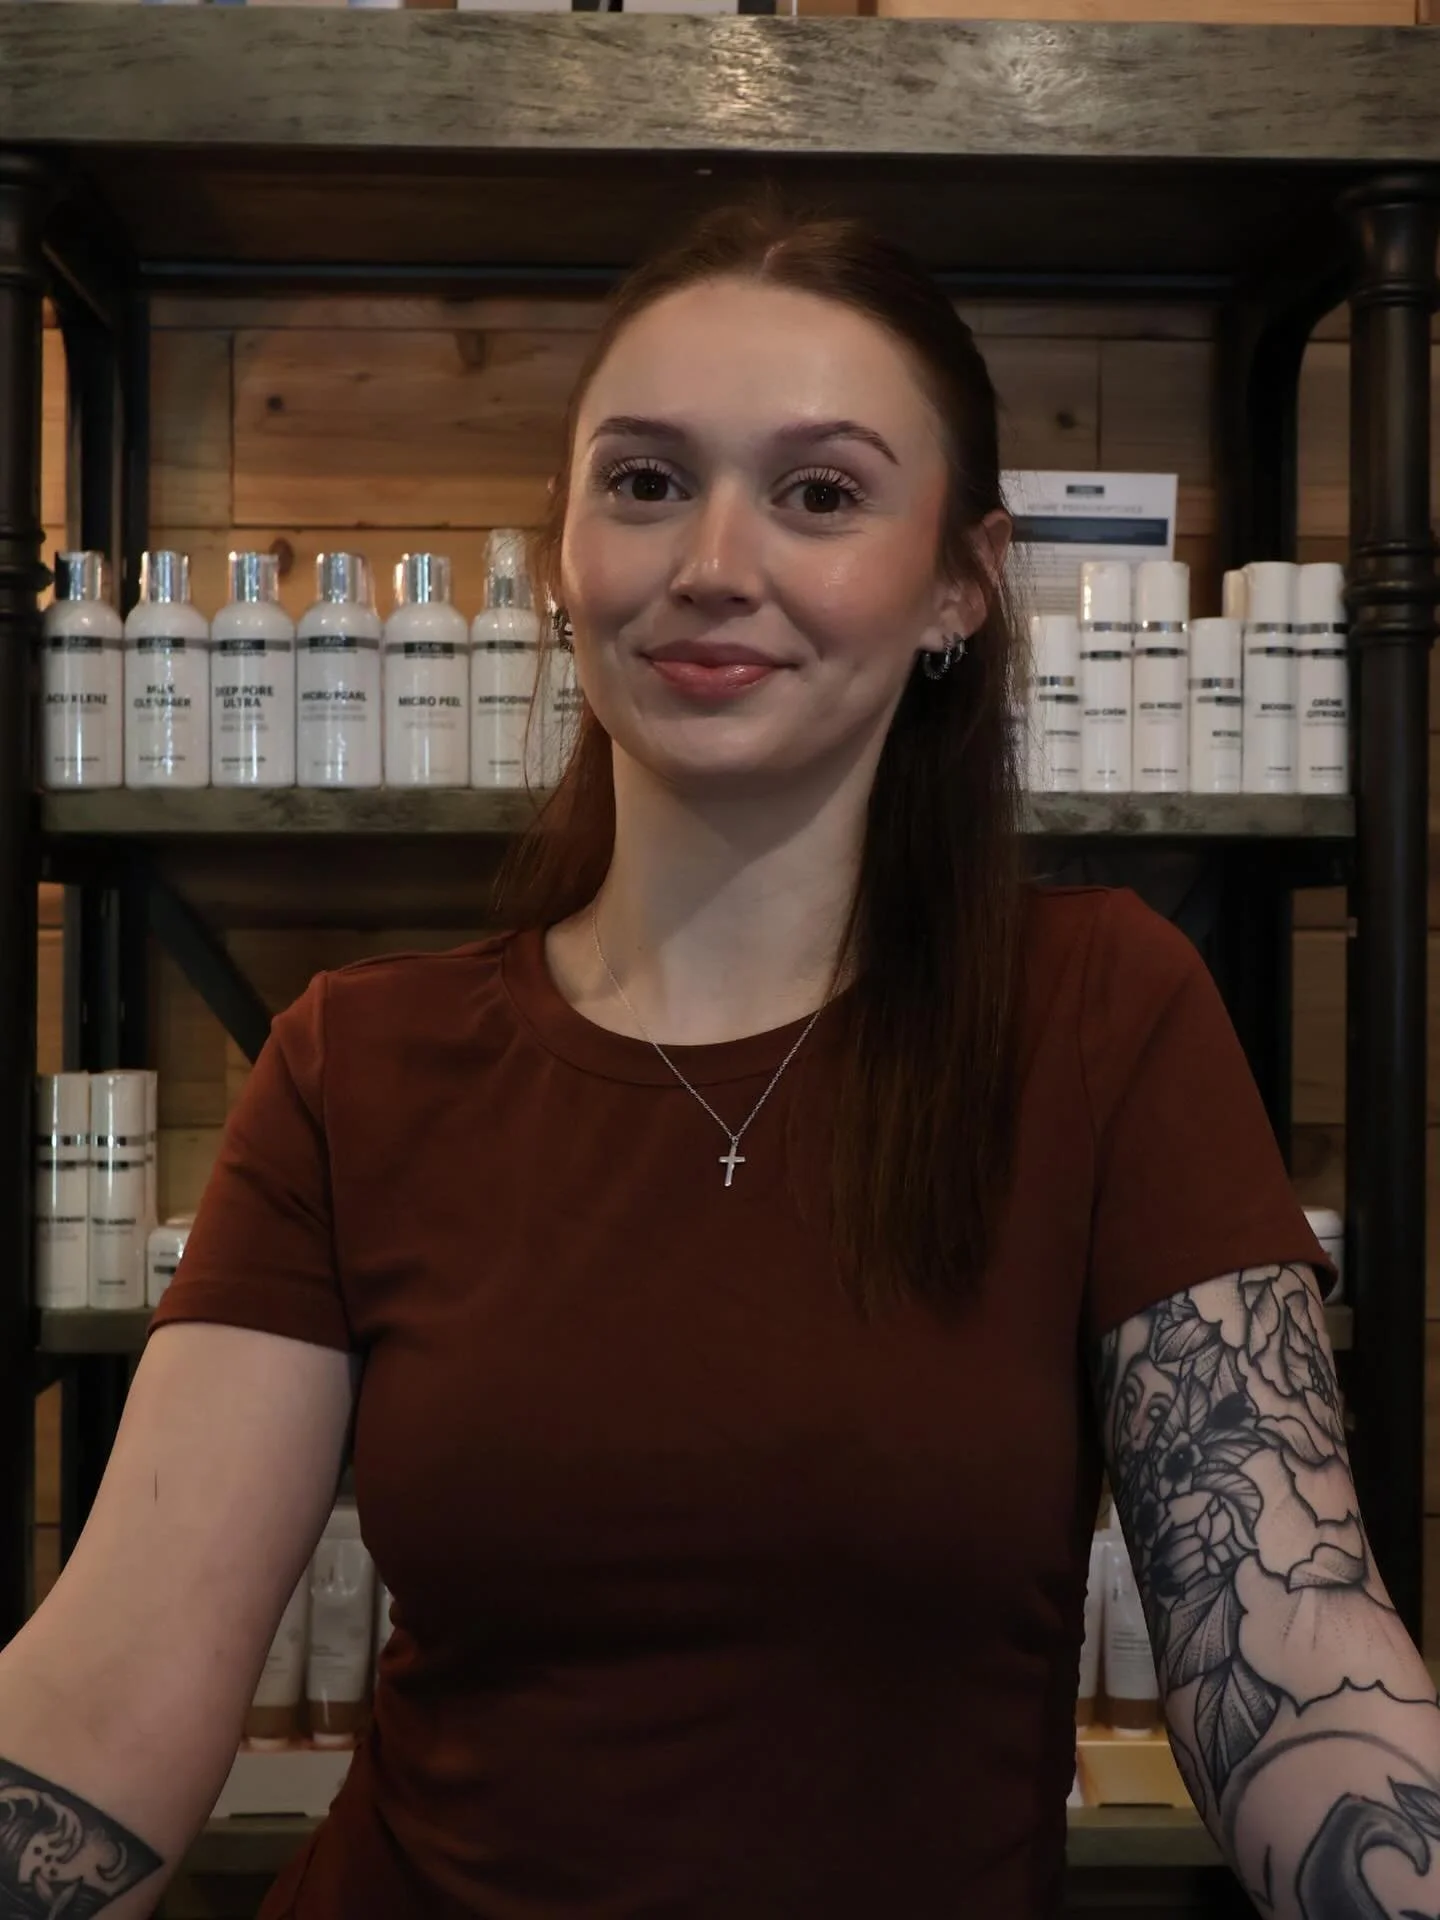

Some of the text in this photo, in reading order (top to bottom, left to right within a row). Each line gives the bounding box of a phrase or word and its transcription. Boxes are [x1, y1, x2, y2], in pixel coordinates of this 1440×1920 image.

[242, 685, 274, 697] PORE
[398, 695, 462, 707] MICRO PEEL
